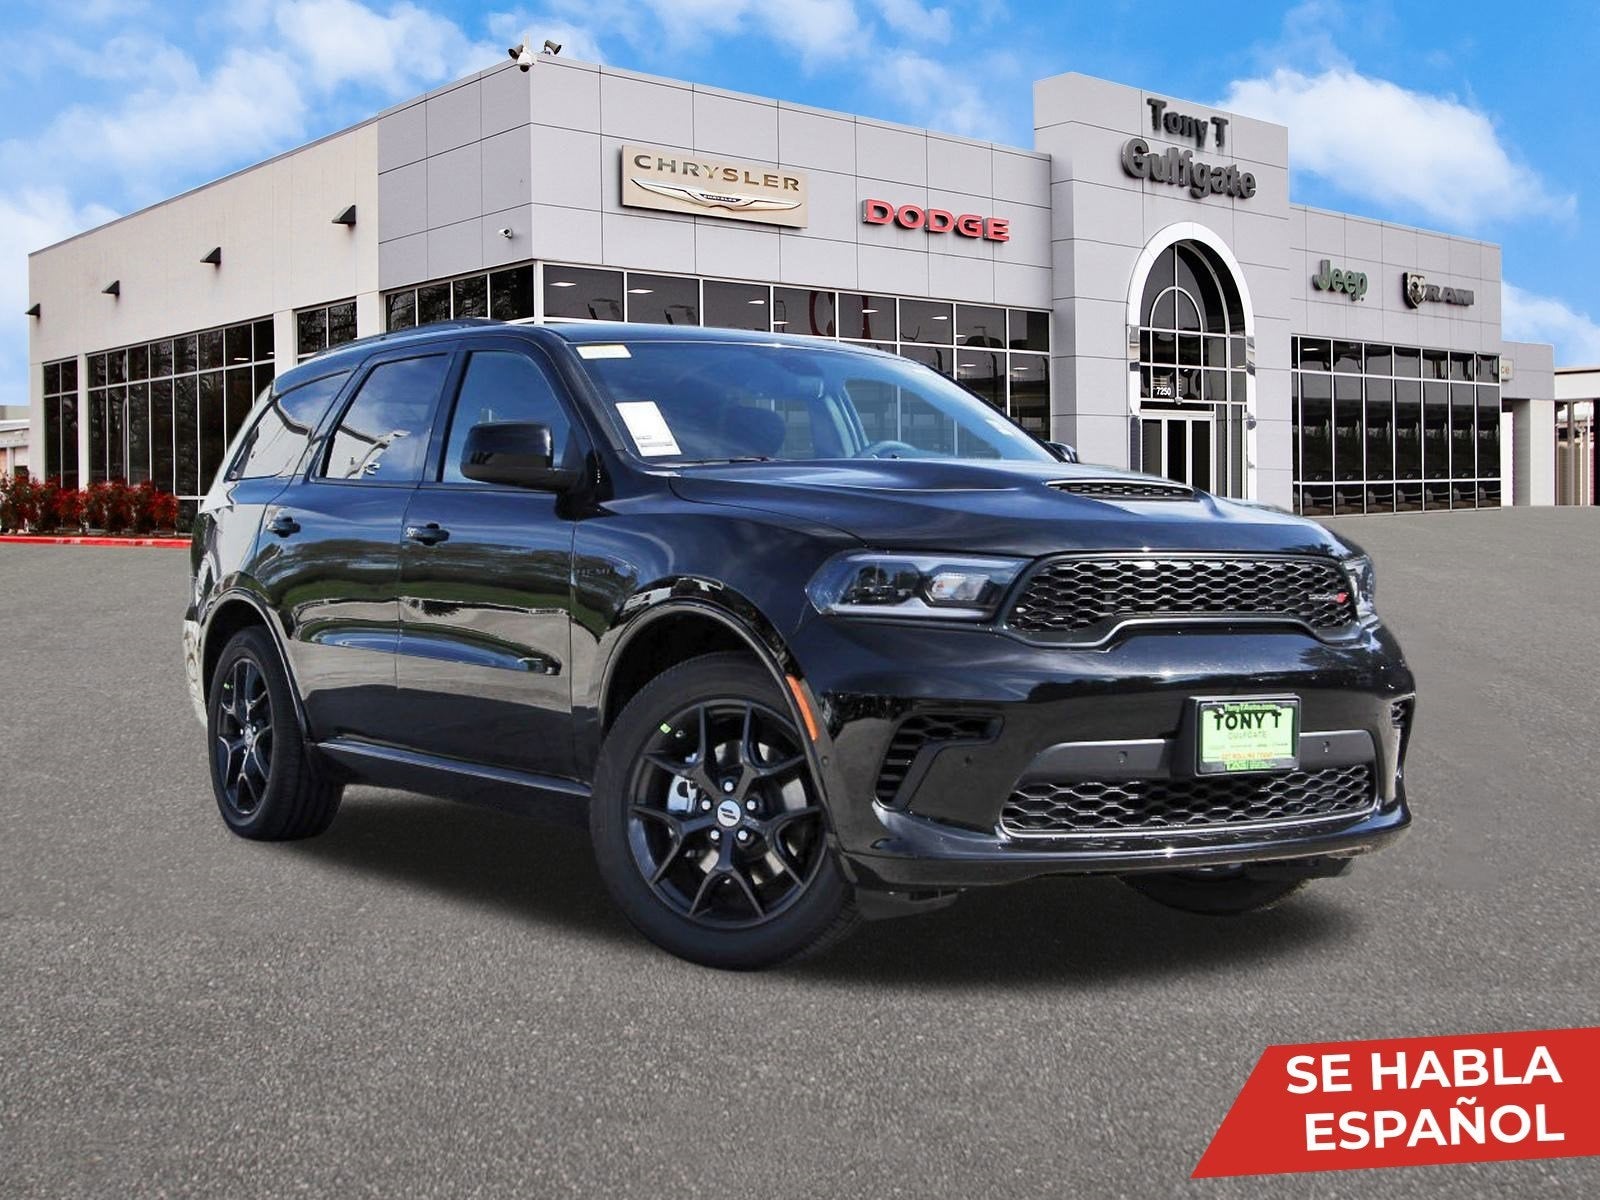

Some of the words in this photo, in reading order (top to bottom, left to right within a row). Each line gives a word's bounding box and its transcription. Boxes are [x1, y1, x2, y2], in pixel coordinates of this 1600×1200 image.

[1147, 98, 1208, 148] Tony
[1210, 116, 1229, 148] T
[632, 153, 801, 193] CHRYSLER
[1121, 137, 1257, 199] Gulfgate
[864, 198, 1011, 242] DODGE
[1312, 259, 1368, 302] Jeep
[1425, 283, 1475, 307] RAM
[1156, 387, 1172, 396] 7250
[1214, 711, 1265, 730] TONY
[1271, 711, 1282, 728] T
